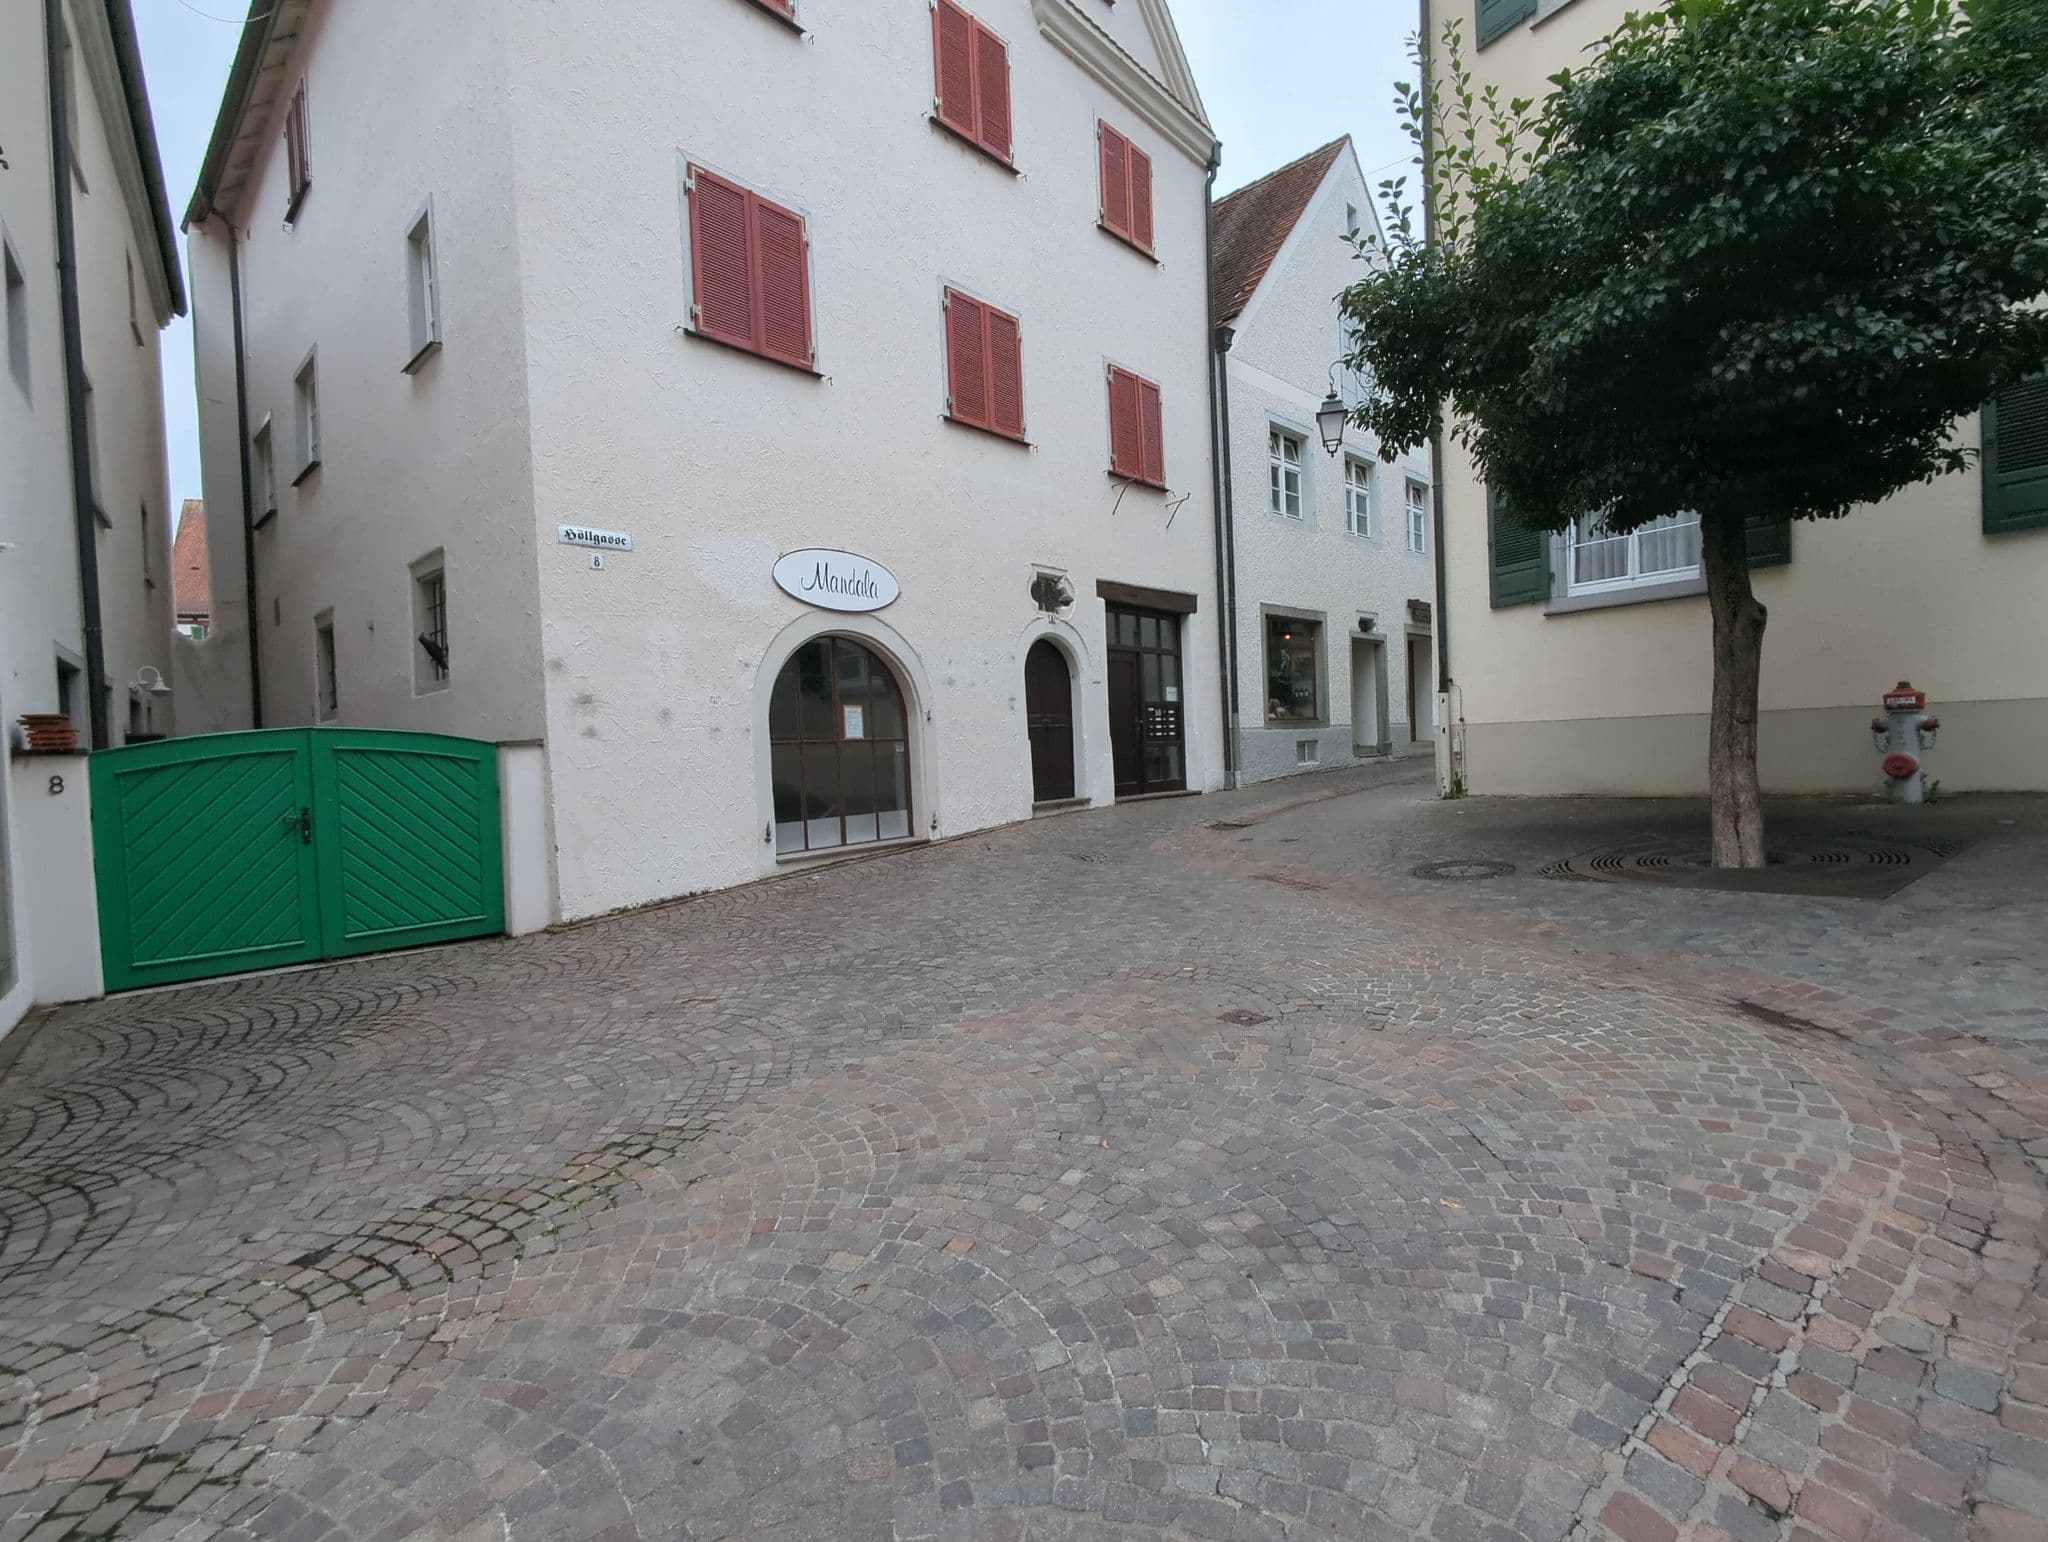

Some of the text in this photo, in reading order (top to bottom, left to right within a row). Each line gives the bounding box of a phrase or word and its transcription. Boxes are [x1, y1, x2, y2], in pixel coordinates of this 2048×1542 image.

[564, 528, 627, 545] Höllgasse
[593, 556, 601, 567] 8
[800, 562, 879, 599] Mandala
[49, 775, 65, 794] 8
